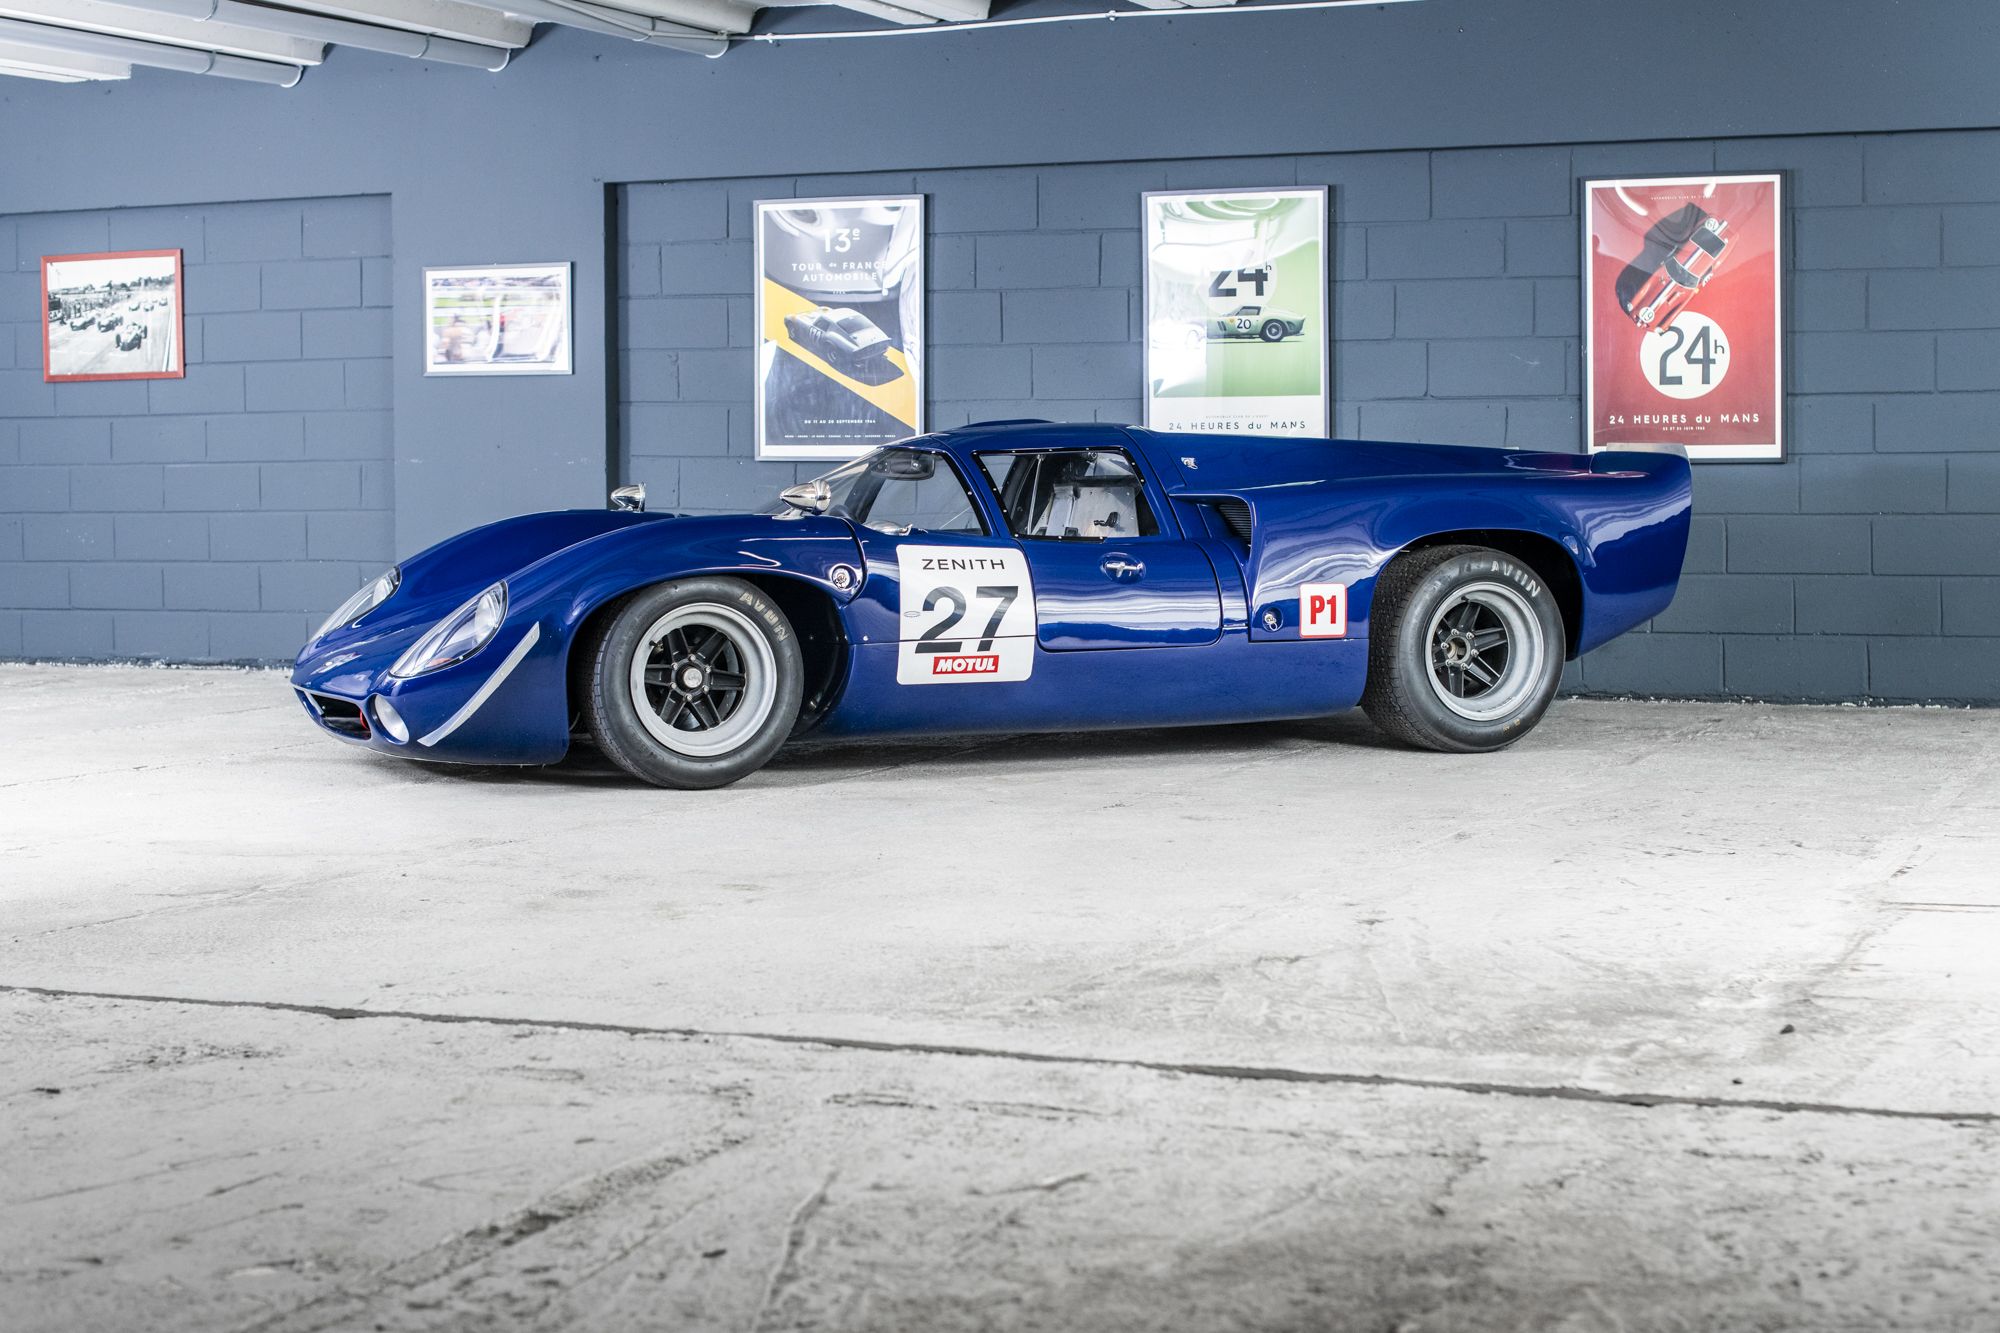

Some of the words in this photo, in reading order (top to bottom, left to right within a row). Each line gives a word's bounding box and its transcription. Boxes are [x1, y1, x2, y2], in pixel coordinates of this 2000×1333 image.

[791, 262, 822, 272] TOUR
[802, 272, 877, 282] AUTOMOBILE
[1236, 318, 1252, 330] 20
[1609, 415, 1625, 424] 24
[1634, 414, 1687, 424] HEURES
[1695, 414, 1712, 423] du
[1720, 413, 1760, 423] MANS
[1168, 422, 1183, 431] 24
[1190, 421, 1240, 430] HEURES
[1247, 421, 1262, 430] du
[1270, 420, 1306, 429] MANS
[921, 558, 1005, 571] ZENITH
[1309, 594, 1337, 625] P1
[914, 585, 1019, 654] 27
[935, 657, 996, 673] MOTUL
